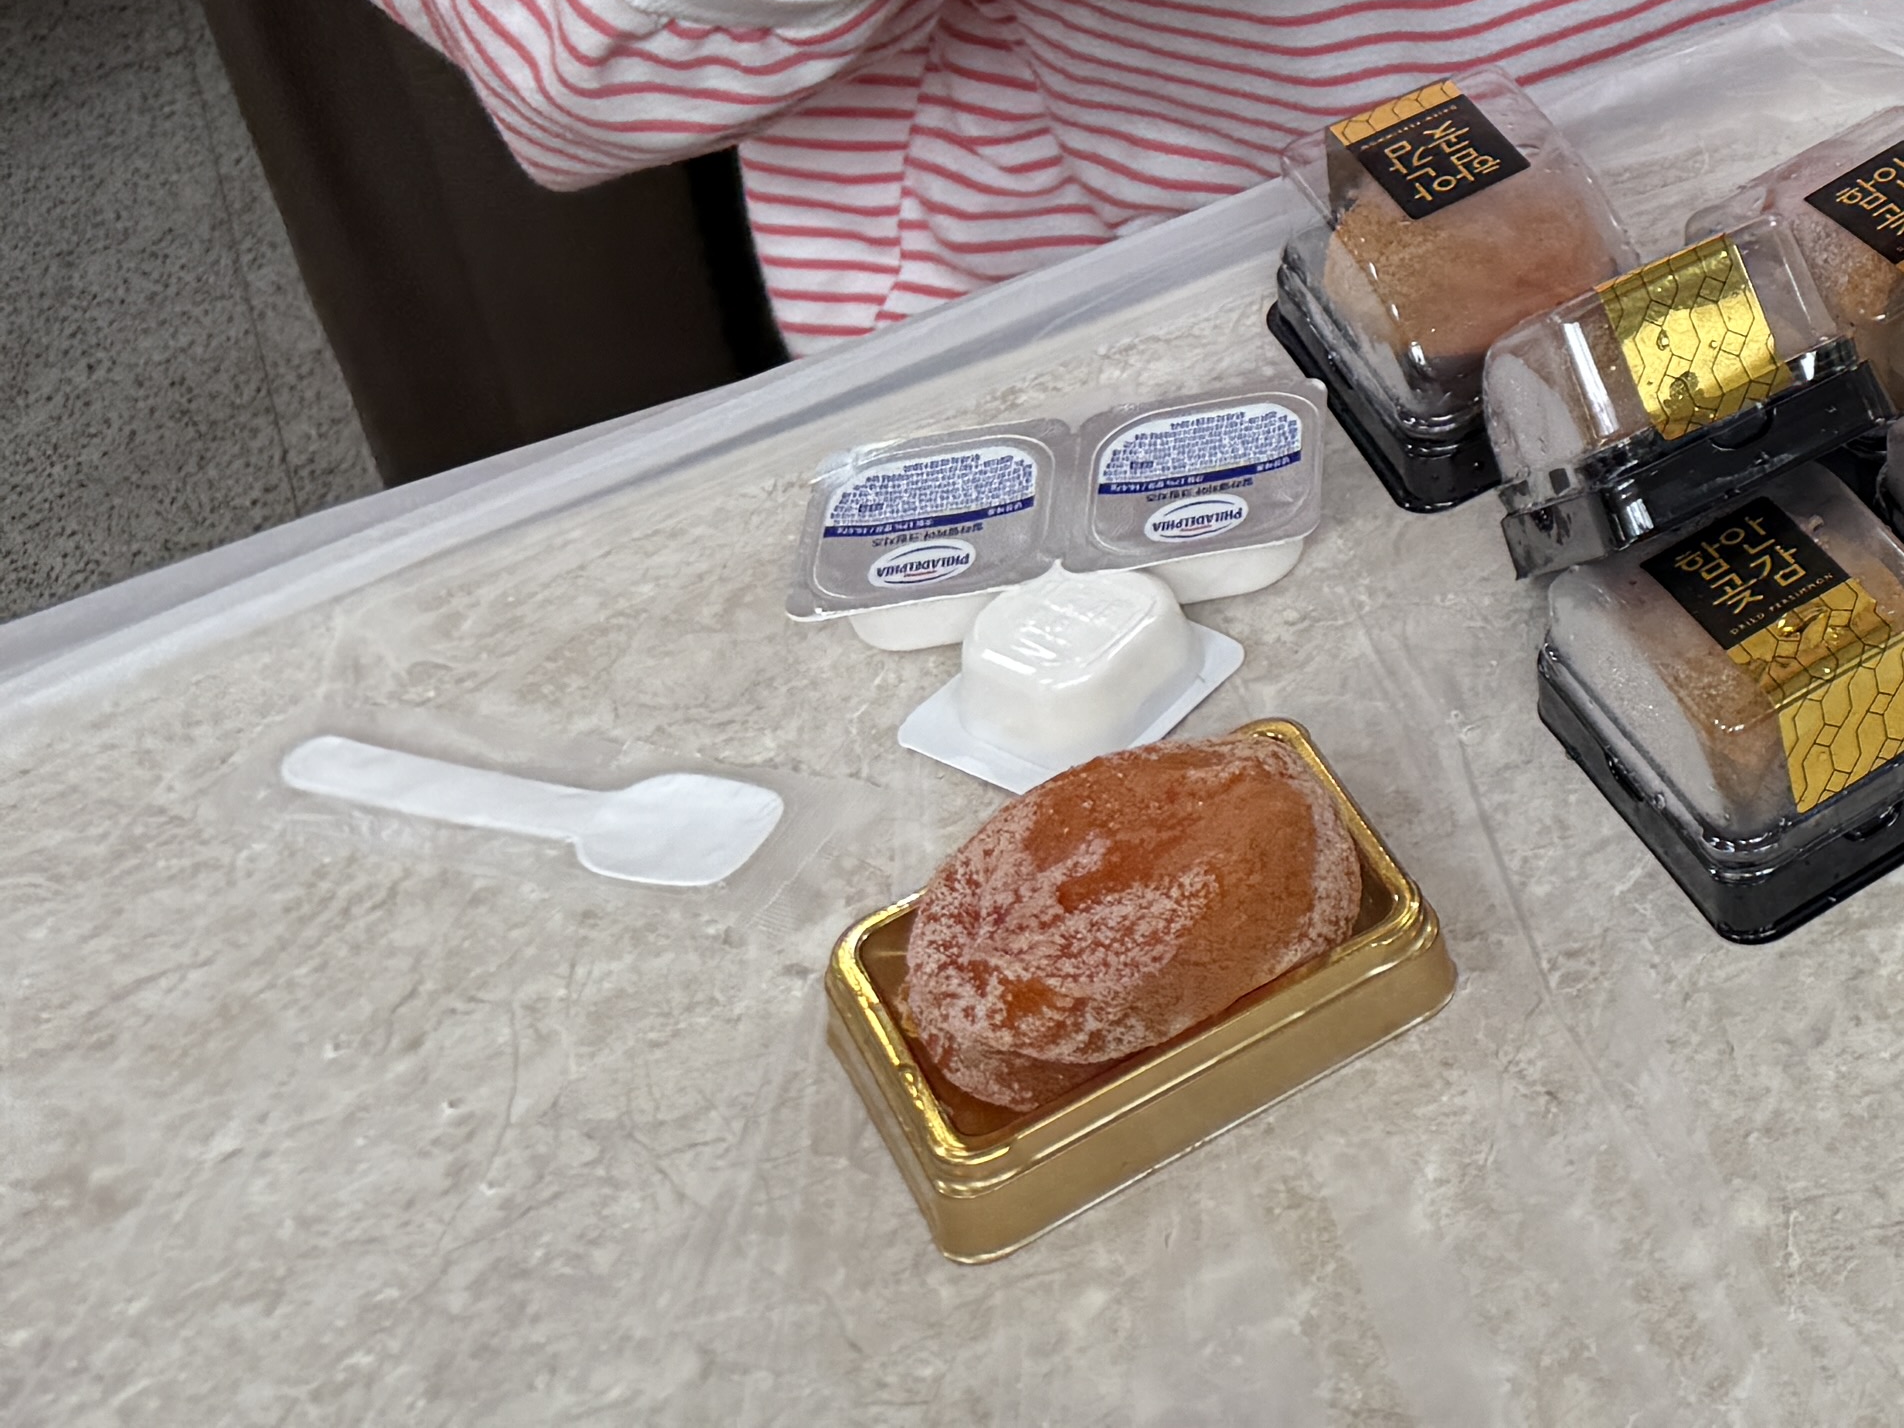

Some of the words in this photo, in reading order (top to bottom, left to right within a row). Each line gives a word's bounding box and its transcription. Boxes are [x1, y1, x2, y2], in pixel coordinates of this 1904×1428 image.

[1384, 120, 1470, 174] 곶감
[1407, 148, 1501, 201] 함안
[1152, 507, 1243, 532] PHILADELPHIA
[877, 552, 970, 578] PHILADELPHIA
[1674, 516, 1775, 580] 함안
[1710, 546, 1807, 614] 곶감
[1730, 612, 1766, 635] DRIED
[1768, 573, 1834, 612] PERSIMMON
